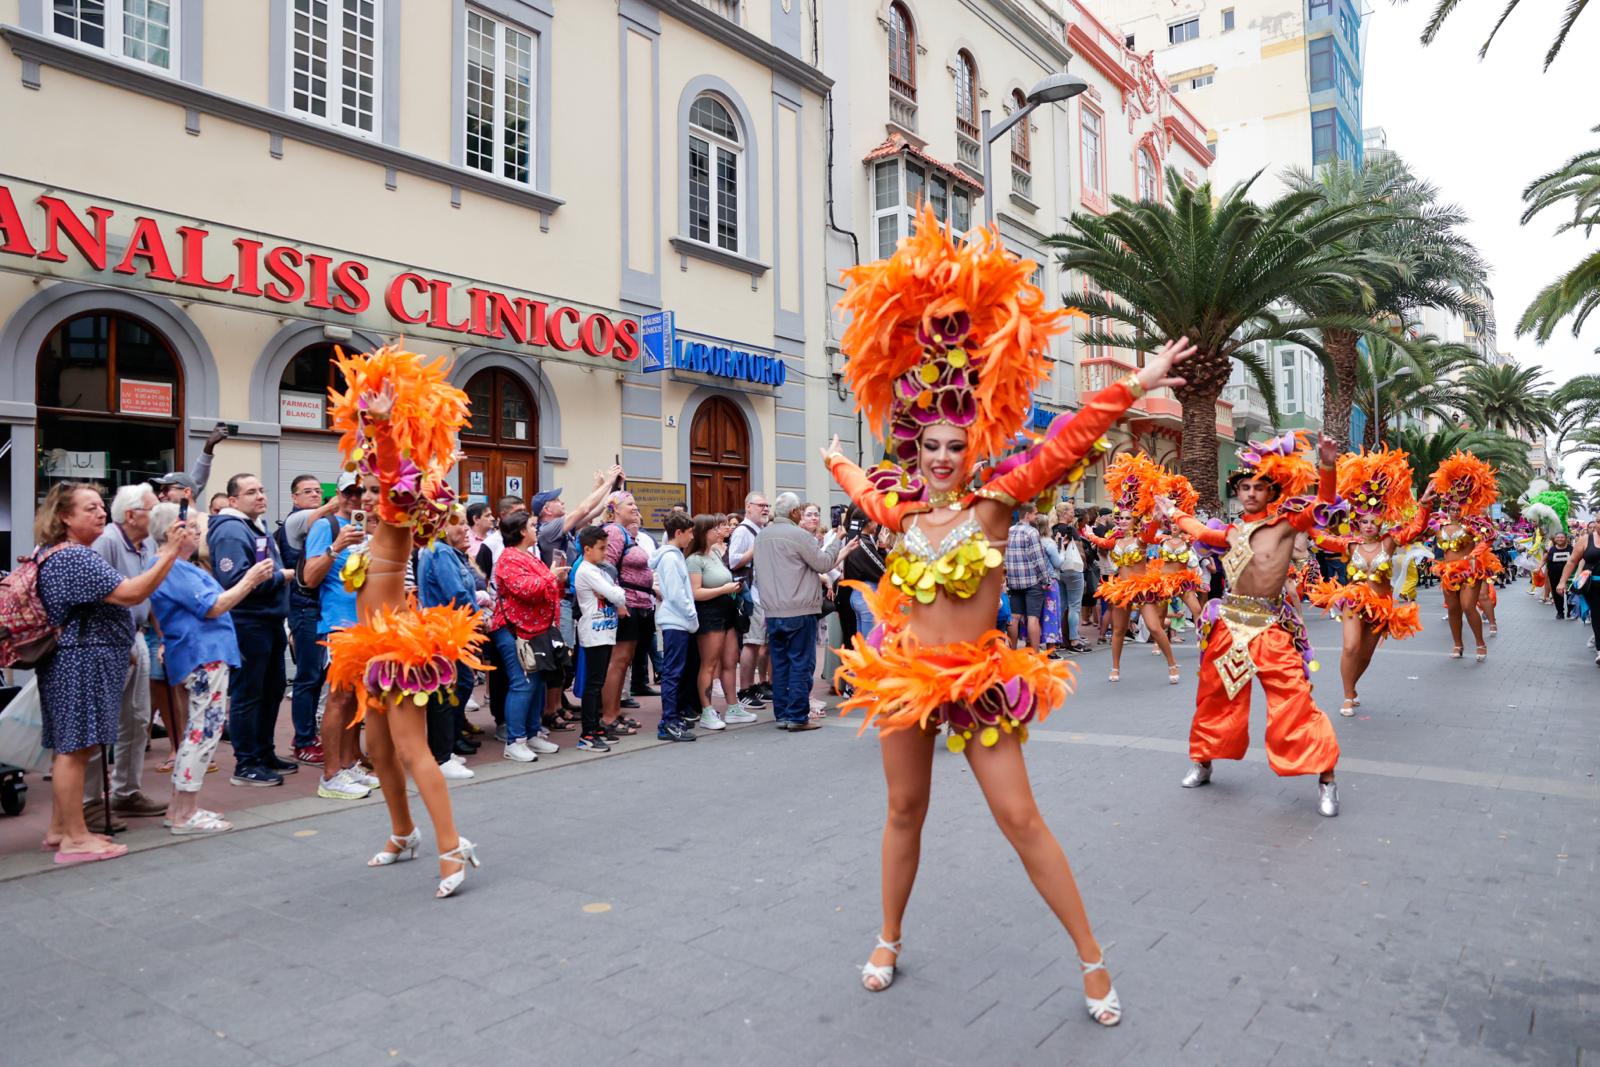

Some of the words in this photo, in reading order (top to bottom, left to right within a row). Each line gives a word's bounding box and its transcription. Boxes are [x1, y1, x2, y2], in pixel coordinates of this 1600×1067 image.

[0, 185, 371, 315] ANALISIS
[384, 272, 639, 362] CLINICOS
[675, 339, 786, 387] LABORATORIO
[281, 399, 320, 409] FARMACIA
[286, 410, 316, 419] BLANCO
[668, 415, 674, 426] 5
